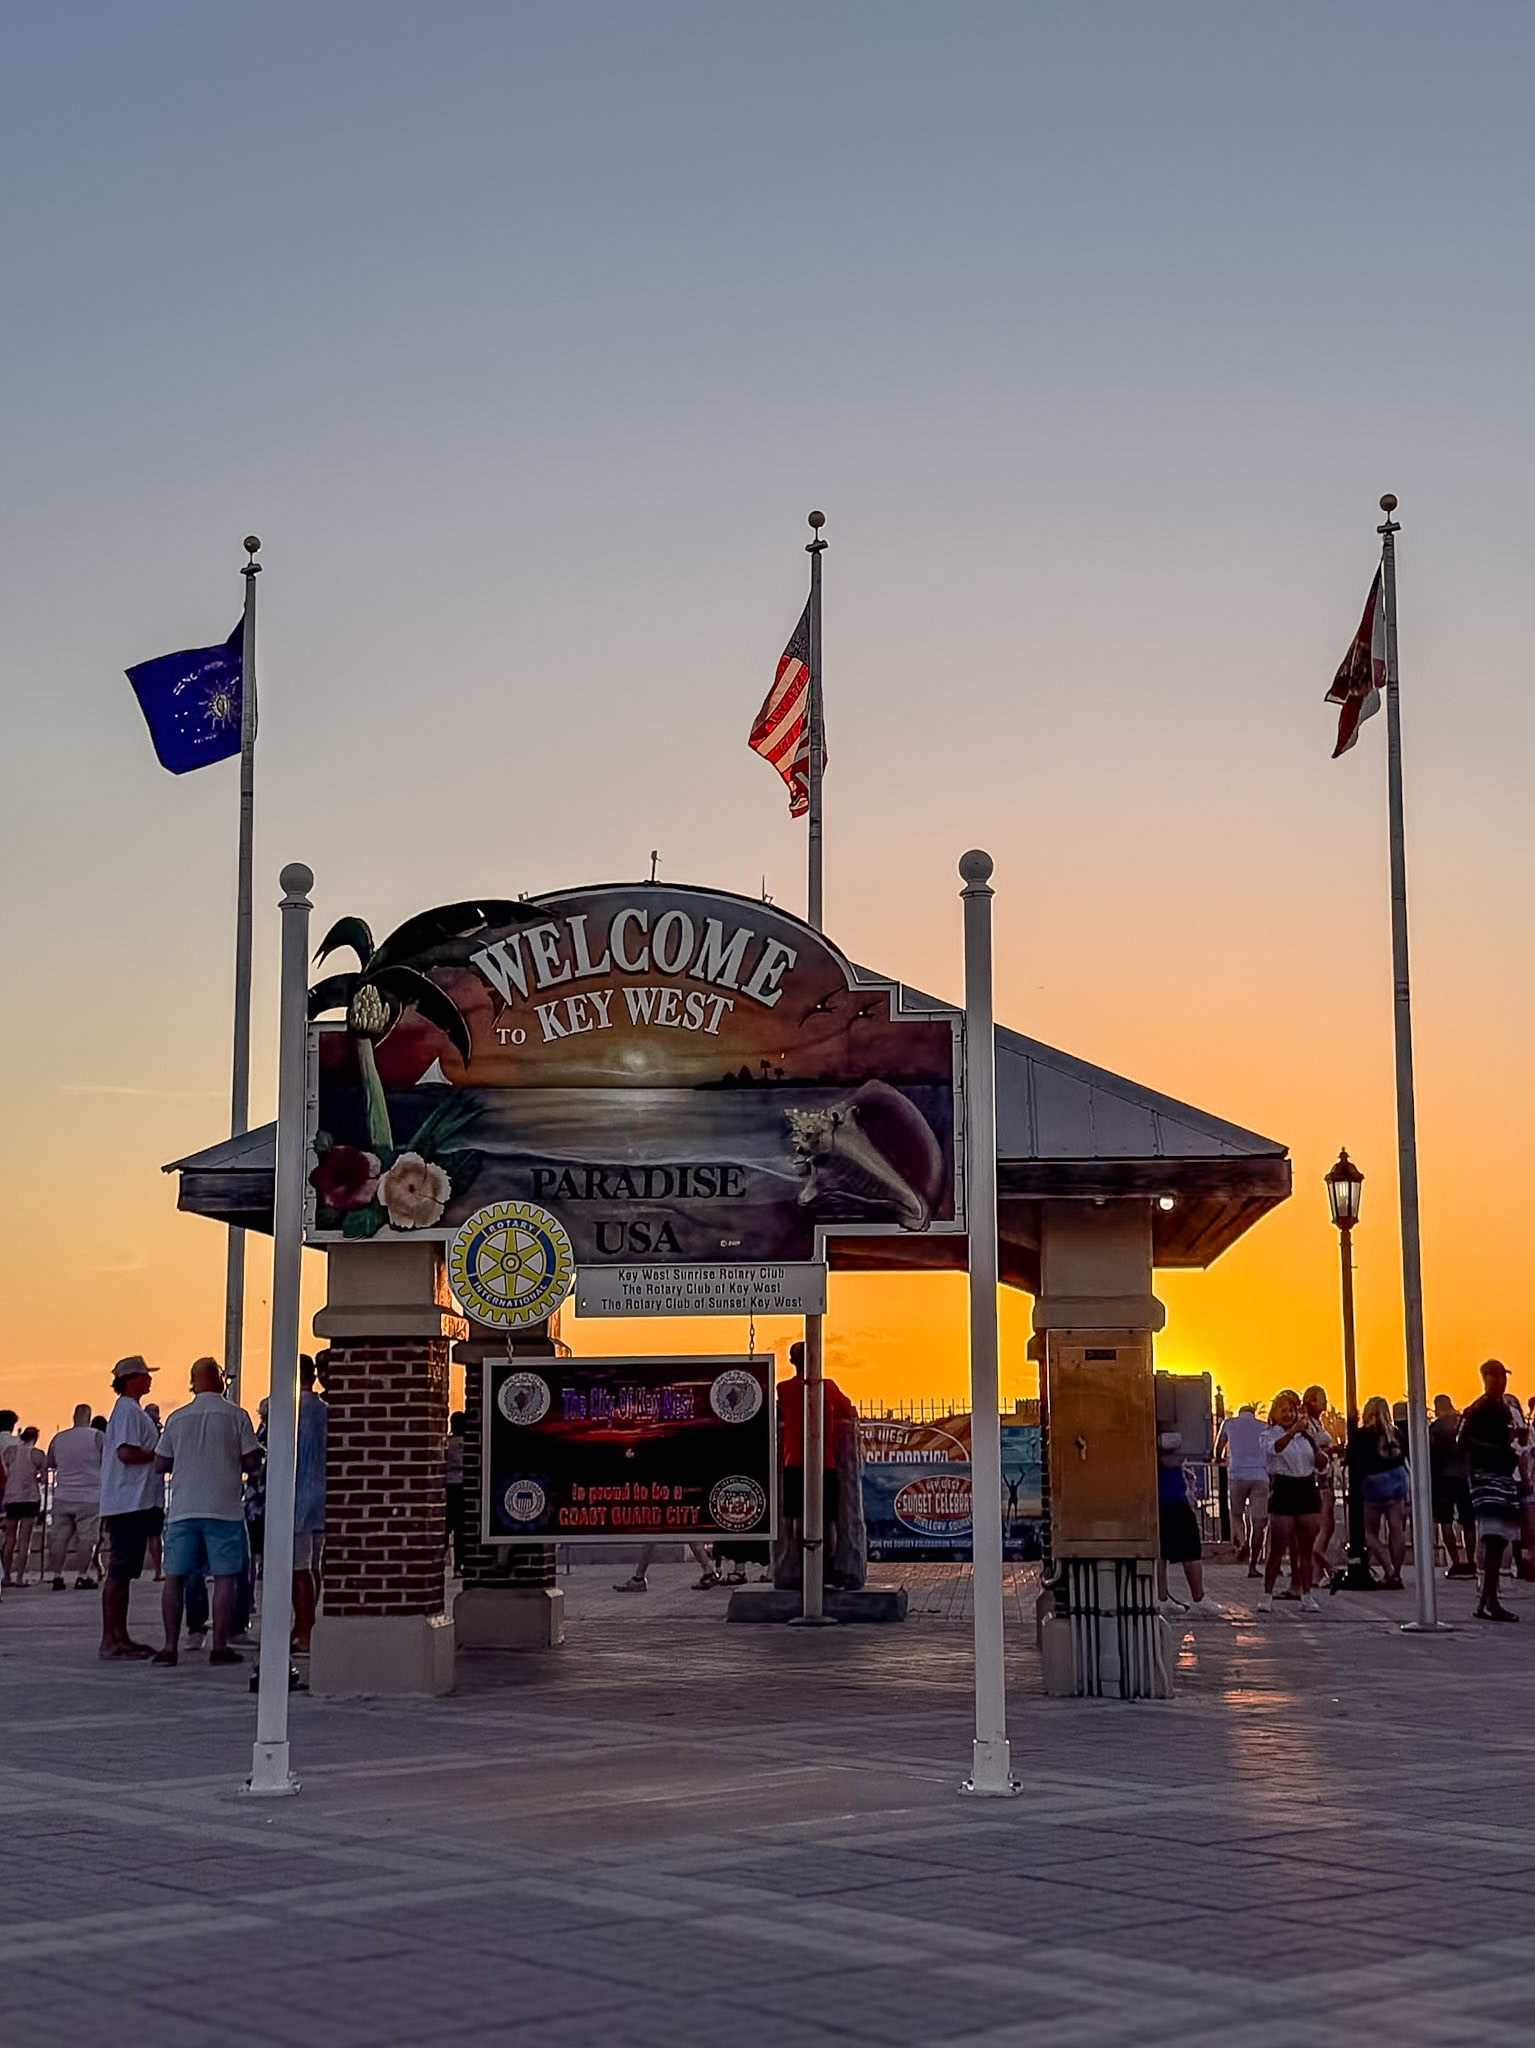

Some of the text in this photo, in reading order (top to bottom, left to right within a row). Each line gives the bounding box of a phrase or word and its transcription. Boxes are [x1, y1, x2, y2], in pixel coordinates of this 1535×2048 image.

[470, 908, 797, 1008] WELCOME
[534, 987, 734, 1043] KEY WEST
[496, 1028, 526, 1045] TO
[530, 1165, 747, 1200] PARADISE
[488, 1219, 536, 1233] ROTARY
[593, 1221, 683, 1255] USA
[618, 1267, 784, 1283] Key West Sunrise Rotary Club
[473, 1281, 548, 1307] INTERNATIONAL
[622, 1282, 781, 1296] The Rotary Club of Key West
[601, 1296, 802, 1311] The Rotary Club of Sunset Key West
[589, 1482, 630, 1504] proud
[634, 1482, 649, 1500] to
[652, 1482, 670, 1500] be
[903, 1493, 933, 1513] SUNSET
[559, 1505, 701, 1525] COAST GUARD CITY
